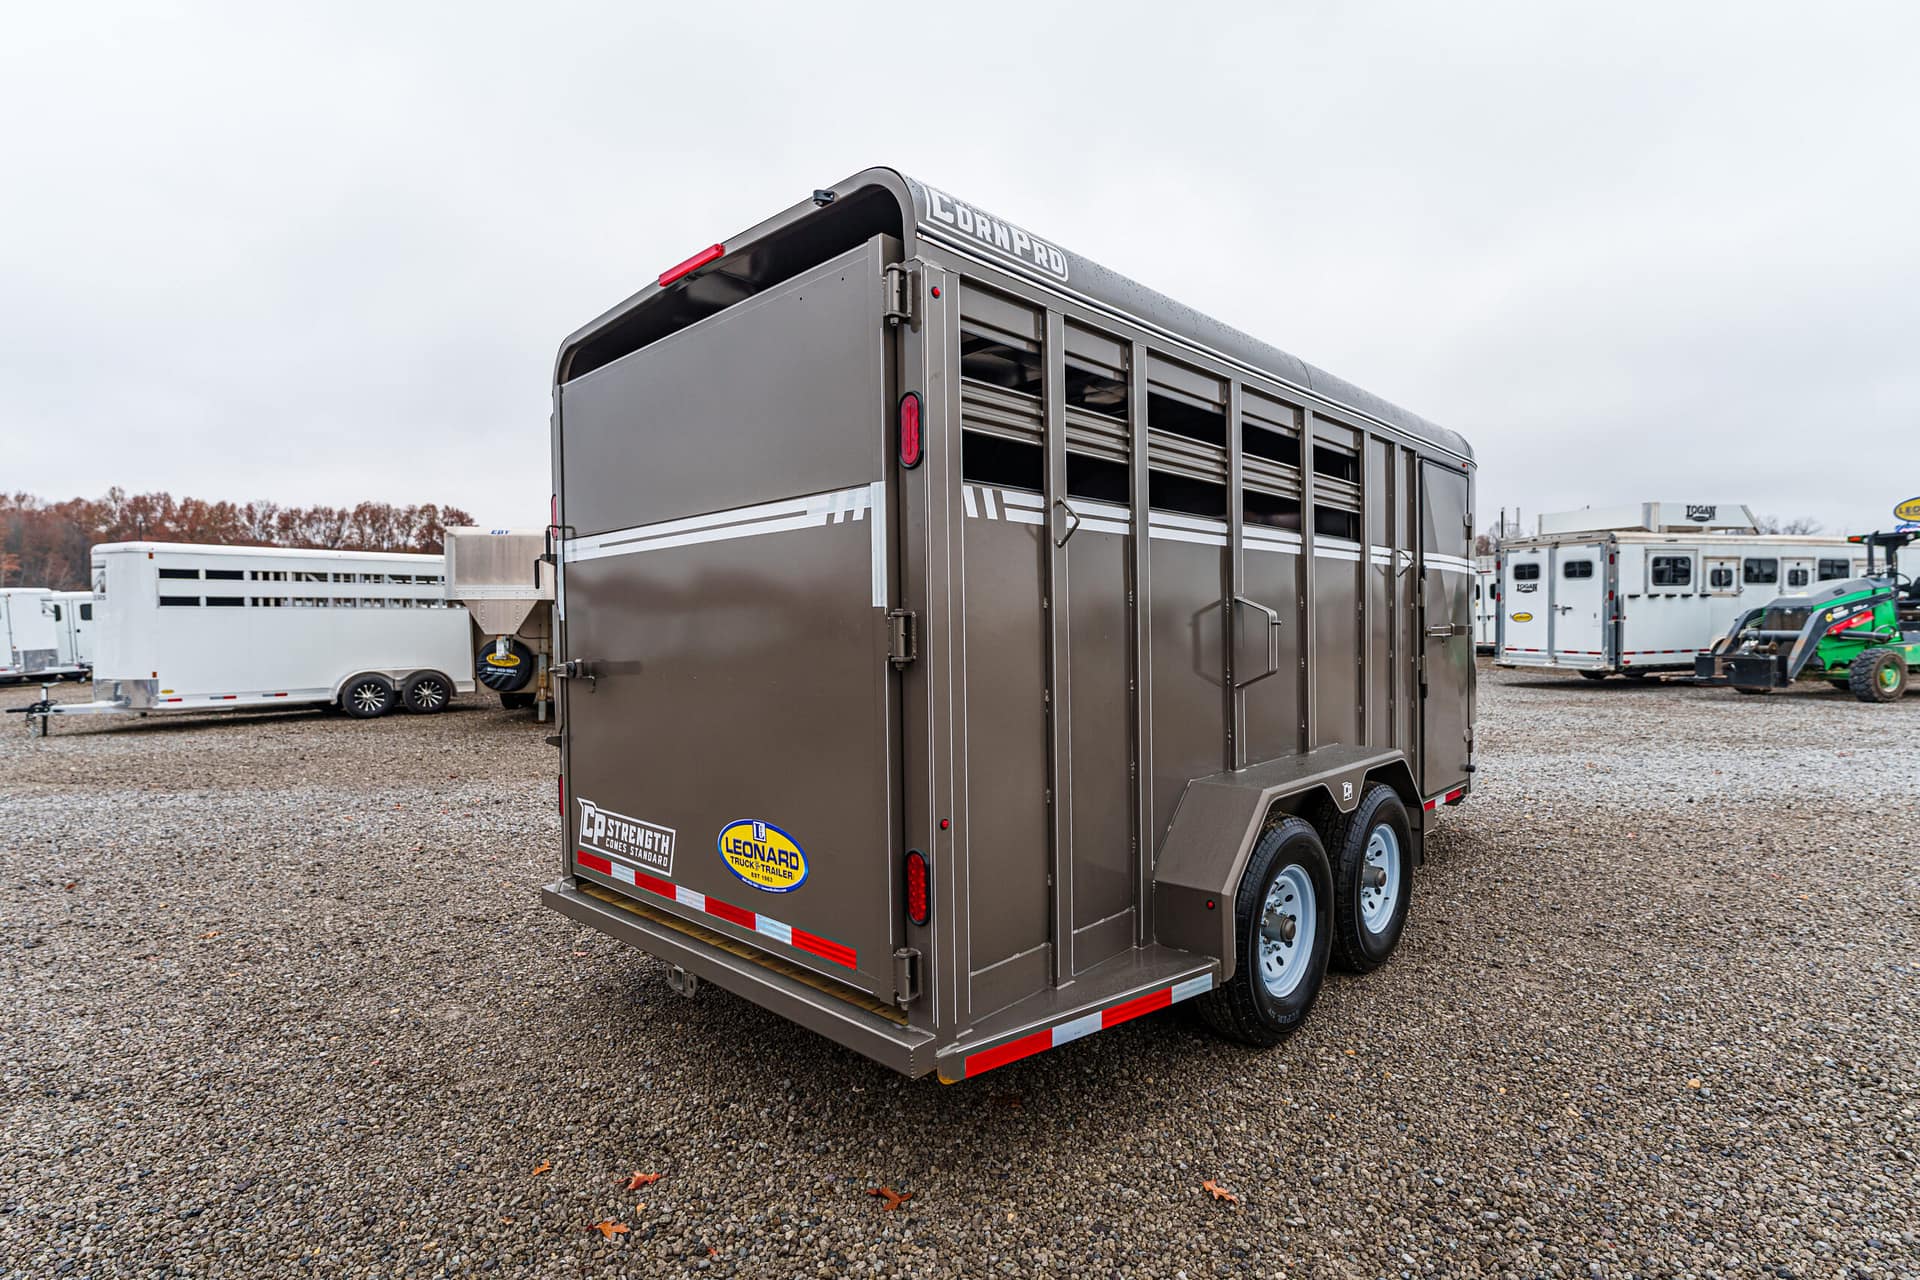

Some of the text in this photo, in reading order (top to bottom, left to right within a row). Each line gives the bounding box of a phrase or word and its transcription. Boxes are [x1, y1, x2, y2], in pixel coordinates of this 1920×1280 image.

[1686, 505, 1716, 520] LOGAN
[1516, 583, 1538, 592] LOGAN
[583, 805, 606, 845] CP
[607, 818, 670, 855] STRENGTH
[605, 838, 668, 867] COMES STANDARD
[725, 836, 799, 871] LEONARD
[730, 856, 755, 869] TRUCK
[761, 864, 793, 880] TRAILER
